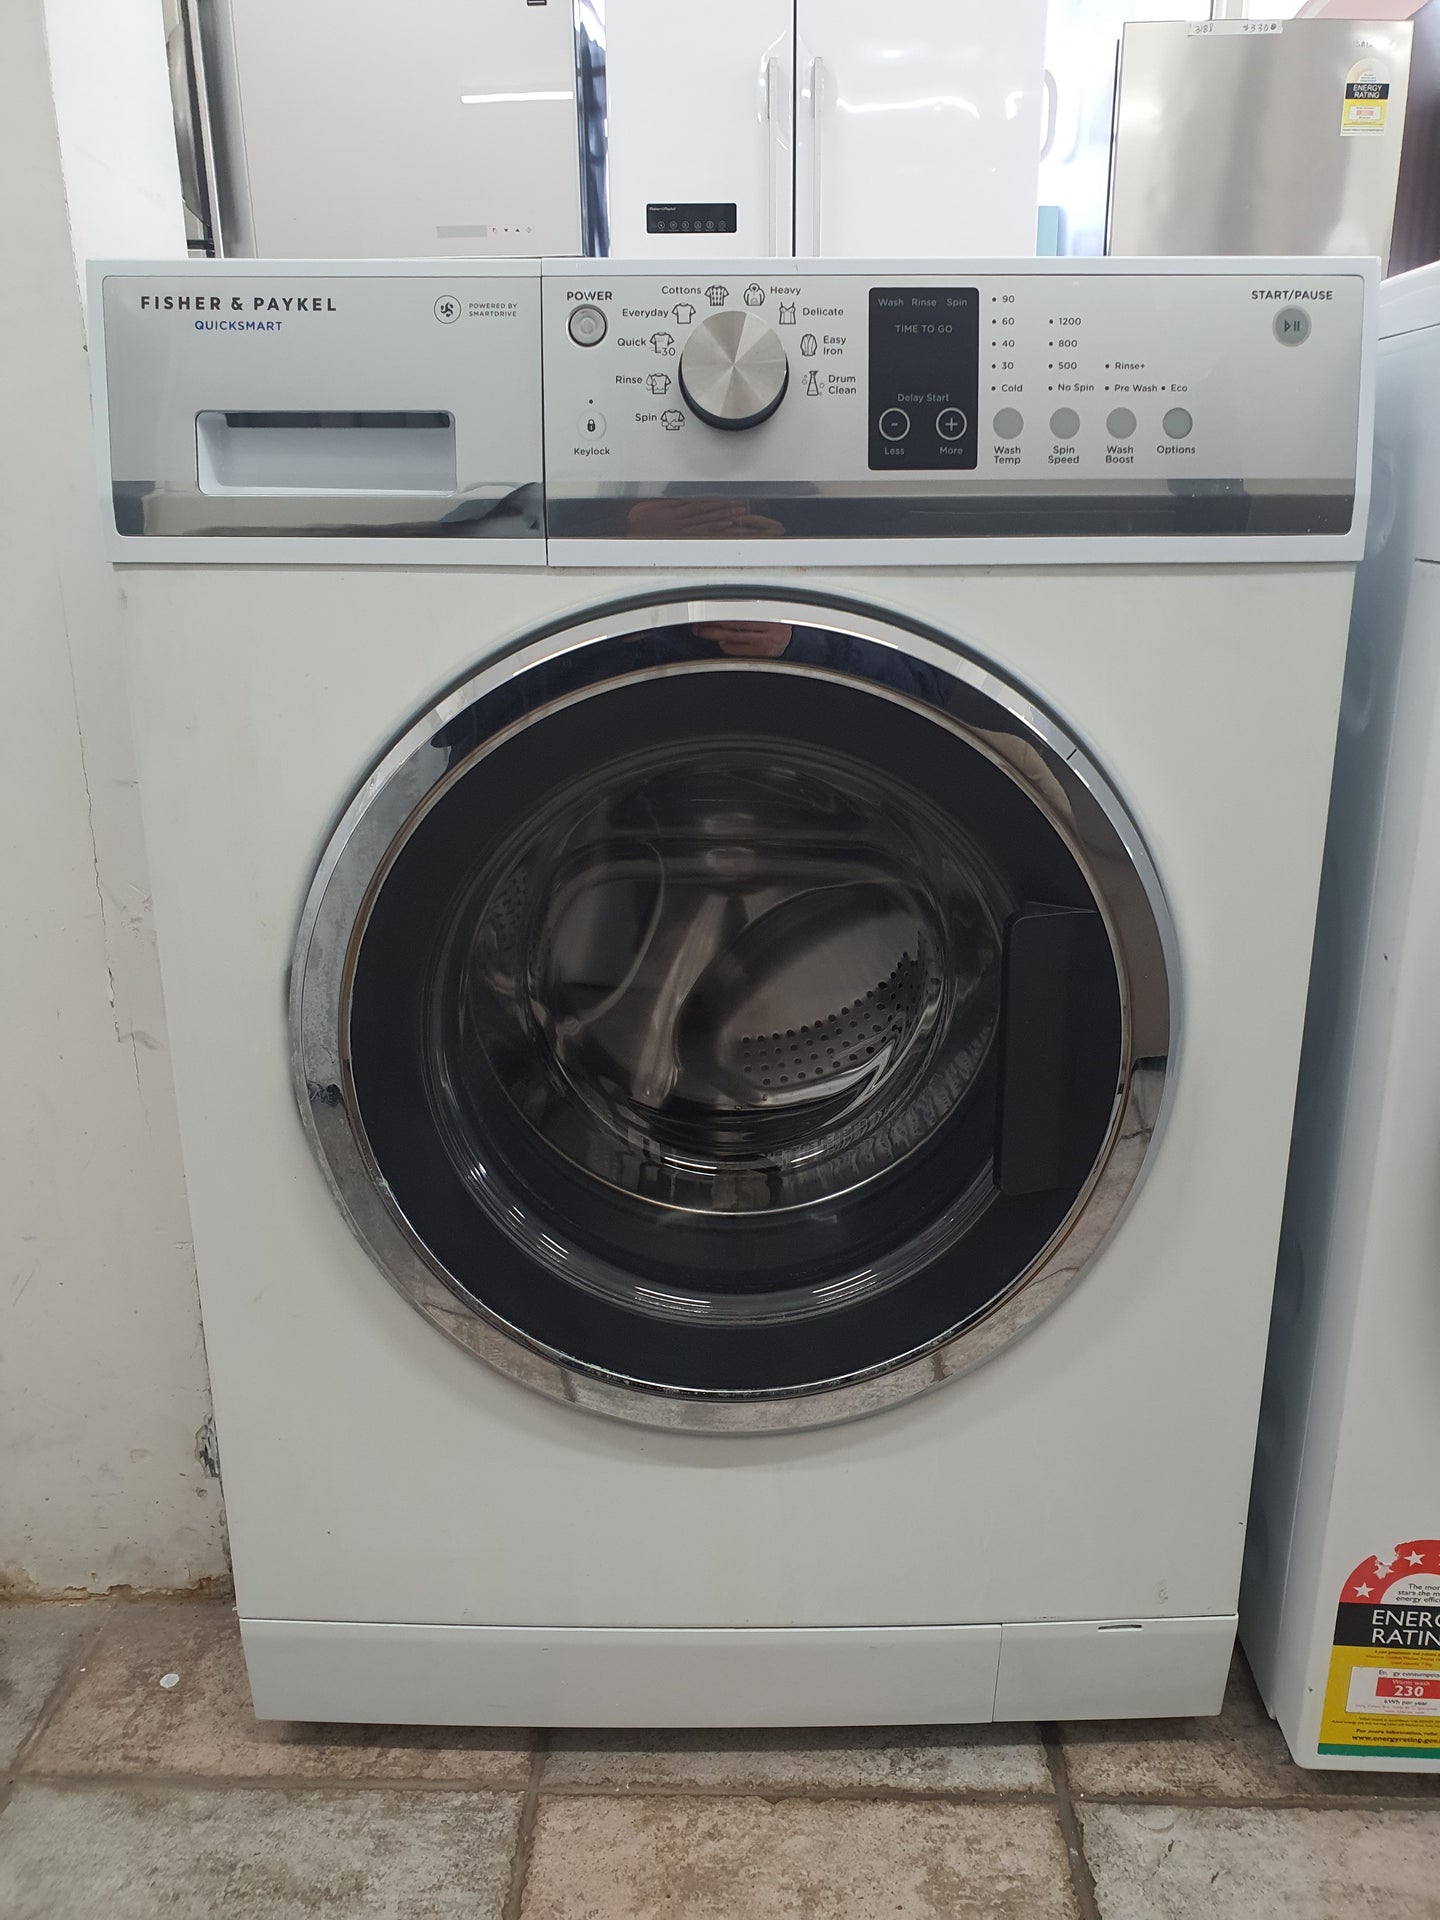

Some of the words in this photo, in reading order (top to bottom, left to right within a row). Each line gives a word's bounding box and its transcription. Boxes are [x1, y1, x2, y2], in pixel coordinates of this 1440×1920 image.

[662, 286, 701, 294] Cottons
[771, 286, 801, 296] Heavy
[567, 291, 612, 301] POWER
[1002, 295, 1015, 303] 90
[1252, 289, 1332, 301] START/PAUSE
[141, 296, 220, 310] FISHER
[231, 297, 243, 310] &
[254, 297, 336, 311] PAYKEL
[878, 298, 904, 307] Wash
[911, 298, 937, 307] Rinse
[946, 298, 968, 307] Spin
[623, 308, 669, 318] Everyday
[803, 307, 843, 316] Delicate
[1002, 317, 1014, 325] 60
[1059, 317, 1081, 325] 1200
[195, 321, 282, 331] QUICKSMART
[895, 325, 918, 333] TIME
[921, 325, 934, 333] TO
[938, 325, 953, 333] GO
[617, 338, 646, 346] Quick
[823, 335, 846, 345] Easy
[661, 347, 676, 356] 30
[824, 347, 842, 355] Iron
[1059, 362, 1077, 370] 500
[616, 376, 642, 384] Rinse
[829, 375, 855, 383] Drum
[829, 386, 856, 394] Clean
[1002, 384, 1022, 392] Cold
[1074, 383, 1094, 392] Spin
[1115, 384, 1129, 392] Pre
[1133, 384, 1157, 392] Wash
[1171, 384, 1187, 392] Eco
[897, 393, 924, 403] Delay
[926, 393, 950, 402] Start
[635, 413, 657, 423] Spin
[574, 448, 610, 456] Keylock
[884, 447, 905, 456] Less
[939, 447, 963, 455] More
[994, 446, 1021, 454] Wash
[1053, 446, 1075, 455] Spin
[1107, 445, 1133, 454] Wash
[1157, 445, 1195, 455] Options
[994, 455, 1021, 465] Temp
[1048, 455, 1079, 464] Speed
[1106, 455, 1133, 463] Boost
[1394, 1685, 1424, 1697] 230
